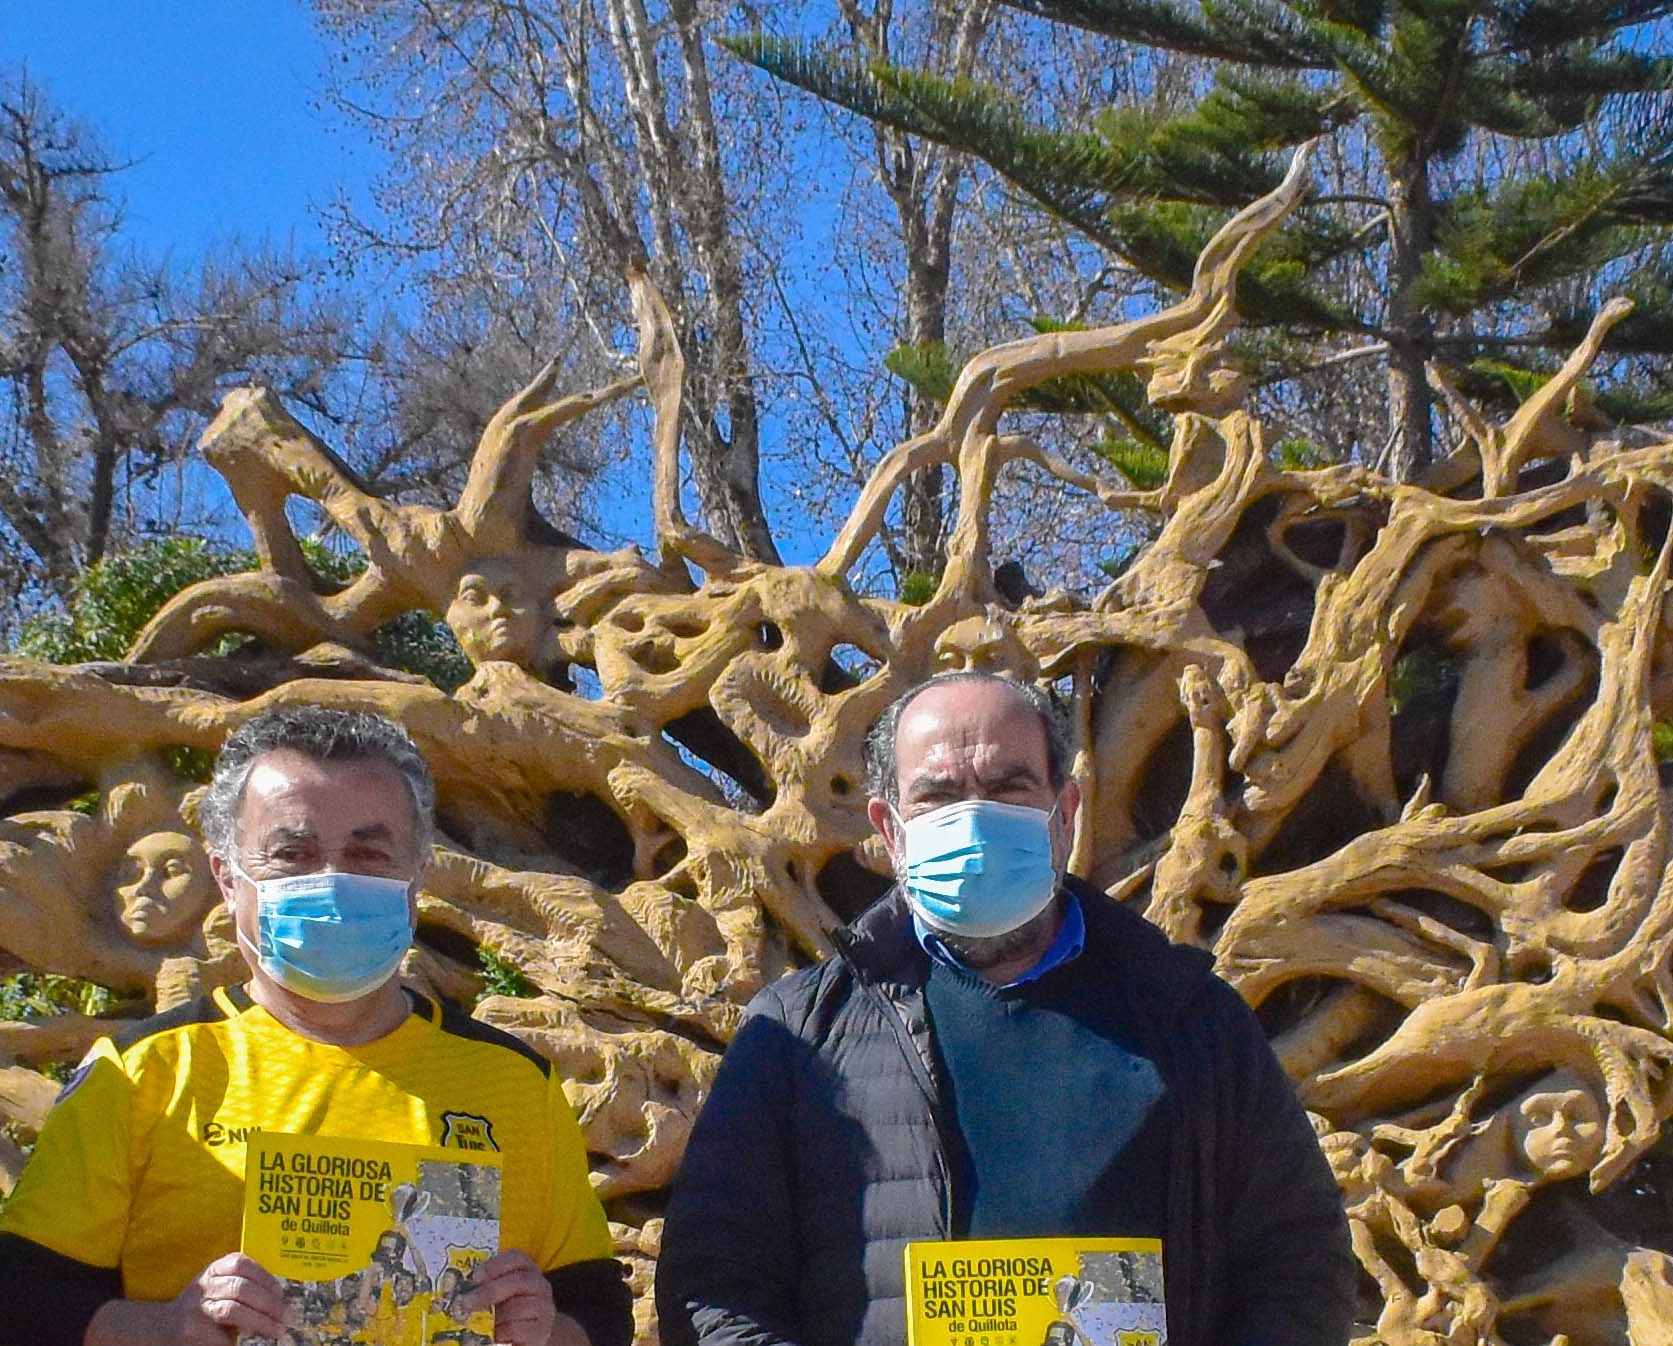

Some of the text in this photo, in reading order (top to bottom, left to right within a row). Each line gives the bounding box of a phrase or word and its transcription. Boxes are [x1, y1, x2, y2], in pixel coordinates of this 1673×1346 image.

[457, 1123, 480, 1136] SAN
[260, 1152, 392, 1181] LA GLORIOSA
[259, 1173, 386, 1203] HISTORIA DE
[258, 1195, 351, 1221] SAN LUIS
[281, 1218, 350, 1236] de Quillota
[921, 1257, 1054, 1279] LA GLORIOSA
[923, 1277, 1049, 1299] HISTORIA DE
[924, 1298, 1017, 1319] SAN LUIS
[948, 1318, 1018, 1333] de Quillota
